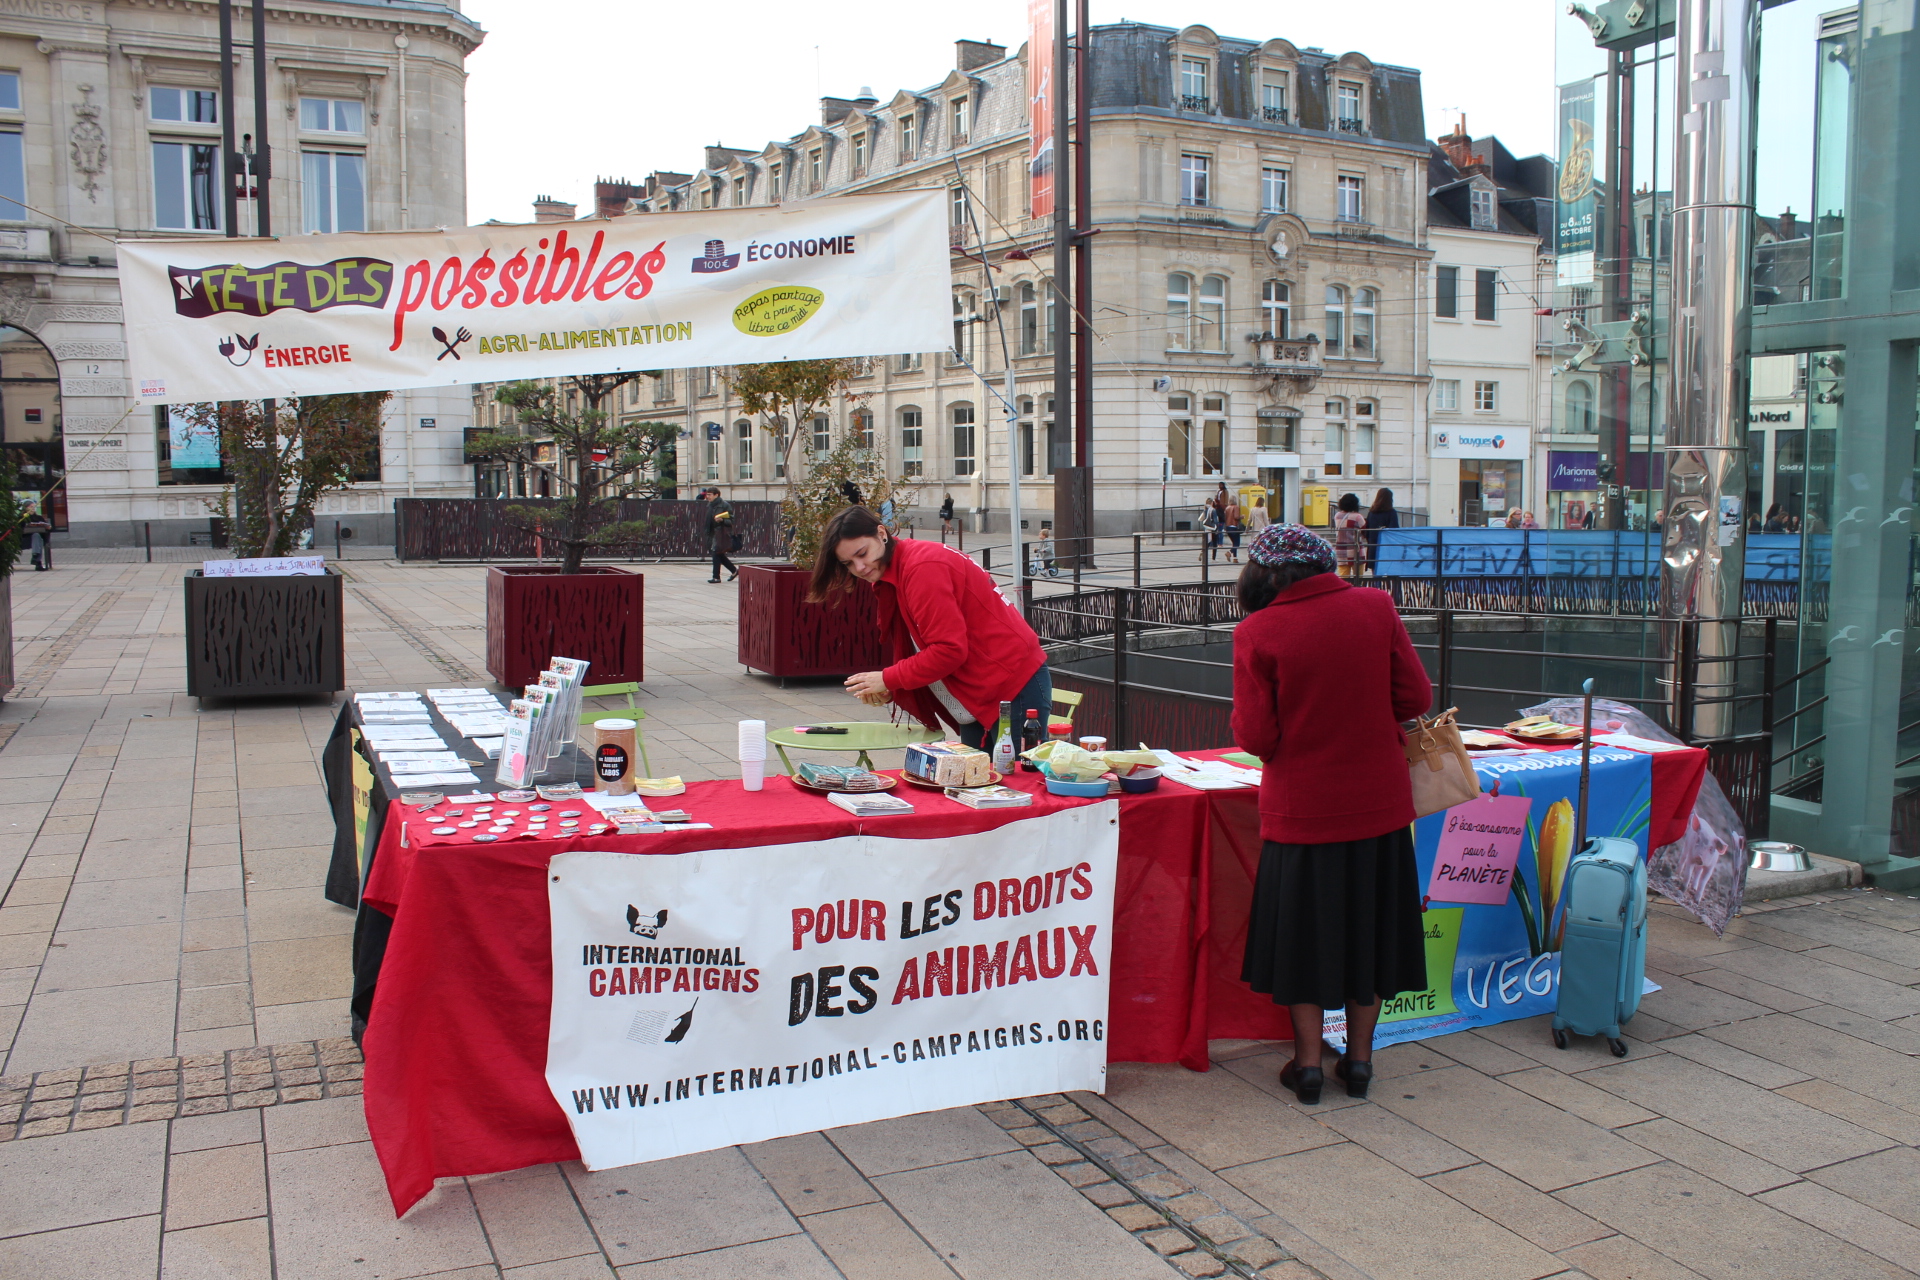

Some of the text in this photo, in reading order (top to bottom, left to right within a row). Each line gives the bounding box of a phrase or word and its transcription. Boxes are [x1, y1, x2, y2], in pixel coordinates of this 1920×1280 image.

[1568, 216, 1575, 228] 8
[1581, 213, 1592, 225] 15
[1560, 225, 1592, 237] OCTOBRE
[703, 258, 730, 269] 100€
[747, 235, 855, 262] ÉCONOMIE
[1177, 250, 1221, 264] POSTES
[202, 229, 667, 352] FÊTE DES possibles
[735, 290, 822, 321] Repas partagé
[763, 304, 796, 320] à prix
[749, 307, 809, 333] libre ce midi
[264, 321, 692, 368] ÉNERGIE AGRI-ALIMENTATION
[86, 364, 99, 374] 12
[1750, 410, 1791, 423] u Nord
[69, 439, 90, 448] CHAMBRE
[98, 439, 122, 447] COMMERCE
[1459, 434, 1492, 448] bouygues
[1779, 463, 1799, 471] Crédit
[204, 562, 215, 576] La
[509, 727, 523, 738] VEGAN
[602, 748, 618, 756] STOP
[601, 769, 620, 777] LABOS
[1448, 814, 1522, 836] J'éco-consomme
[1461, 843, 1498, 861] pour la
[1437, 863, 1509, 885] PLANÈTE
[791, 861, 1093, 951] POUR LES DROITS
[582, 944, 746, 966] INTERNATIONAL
[589, 966, 760, 997] CAMPAIGNS
[788, 924, 1099, 1027] DES ANIMAUX
[1466, 951, 1562, 1009] VEG
[1383, 989, 1436, 1015] SANTÉ
[571, 1018, 1104, 1115] WWW.INTERNATIONAL-CAMPAIGNS.ORG
